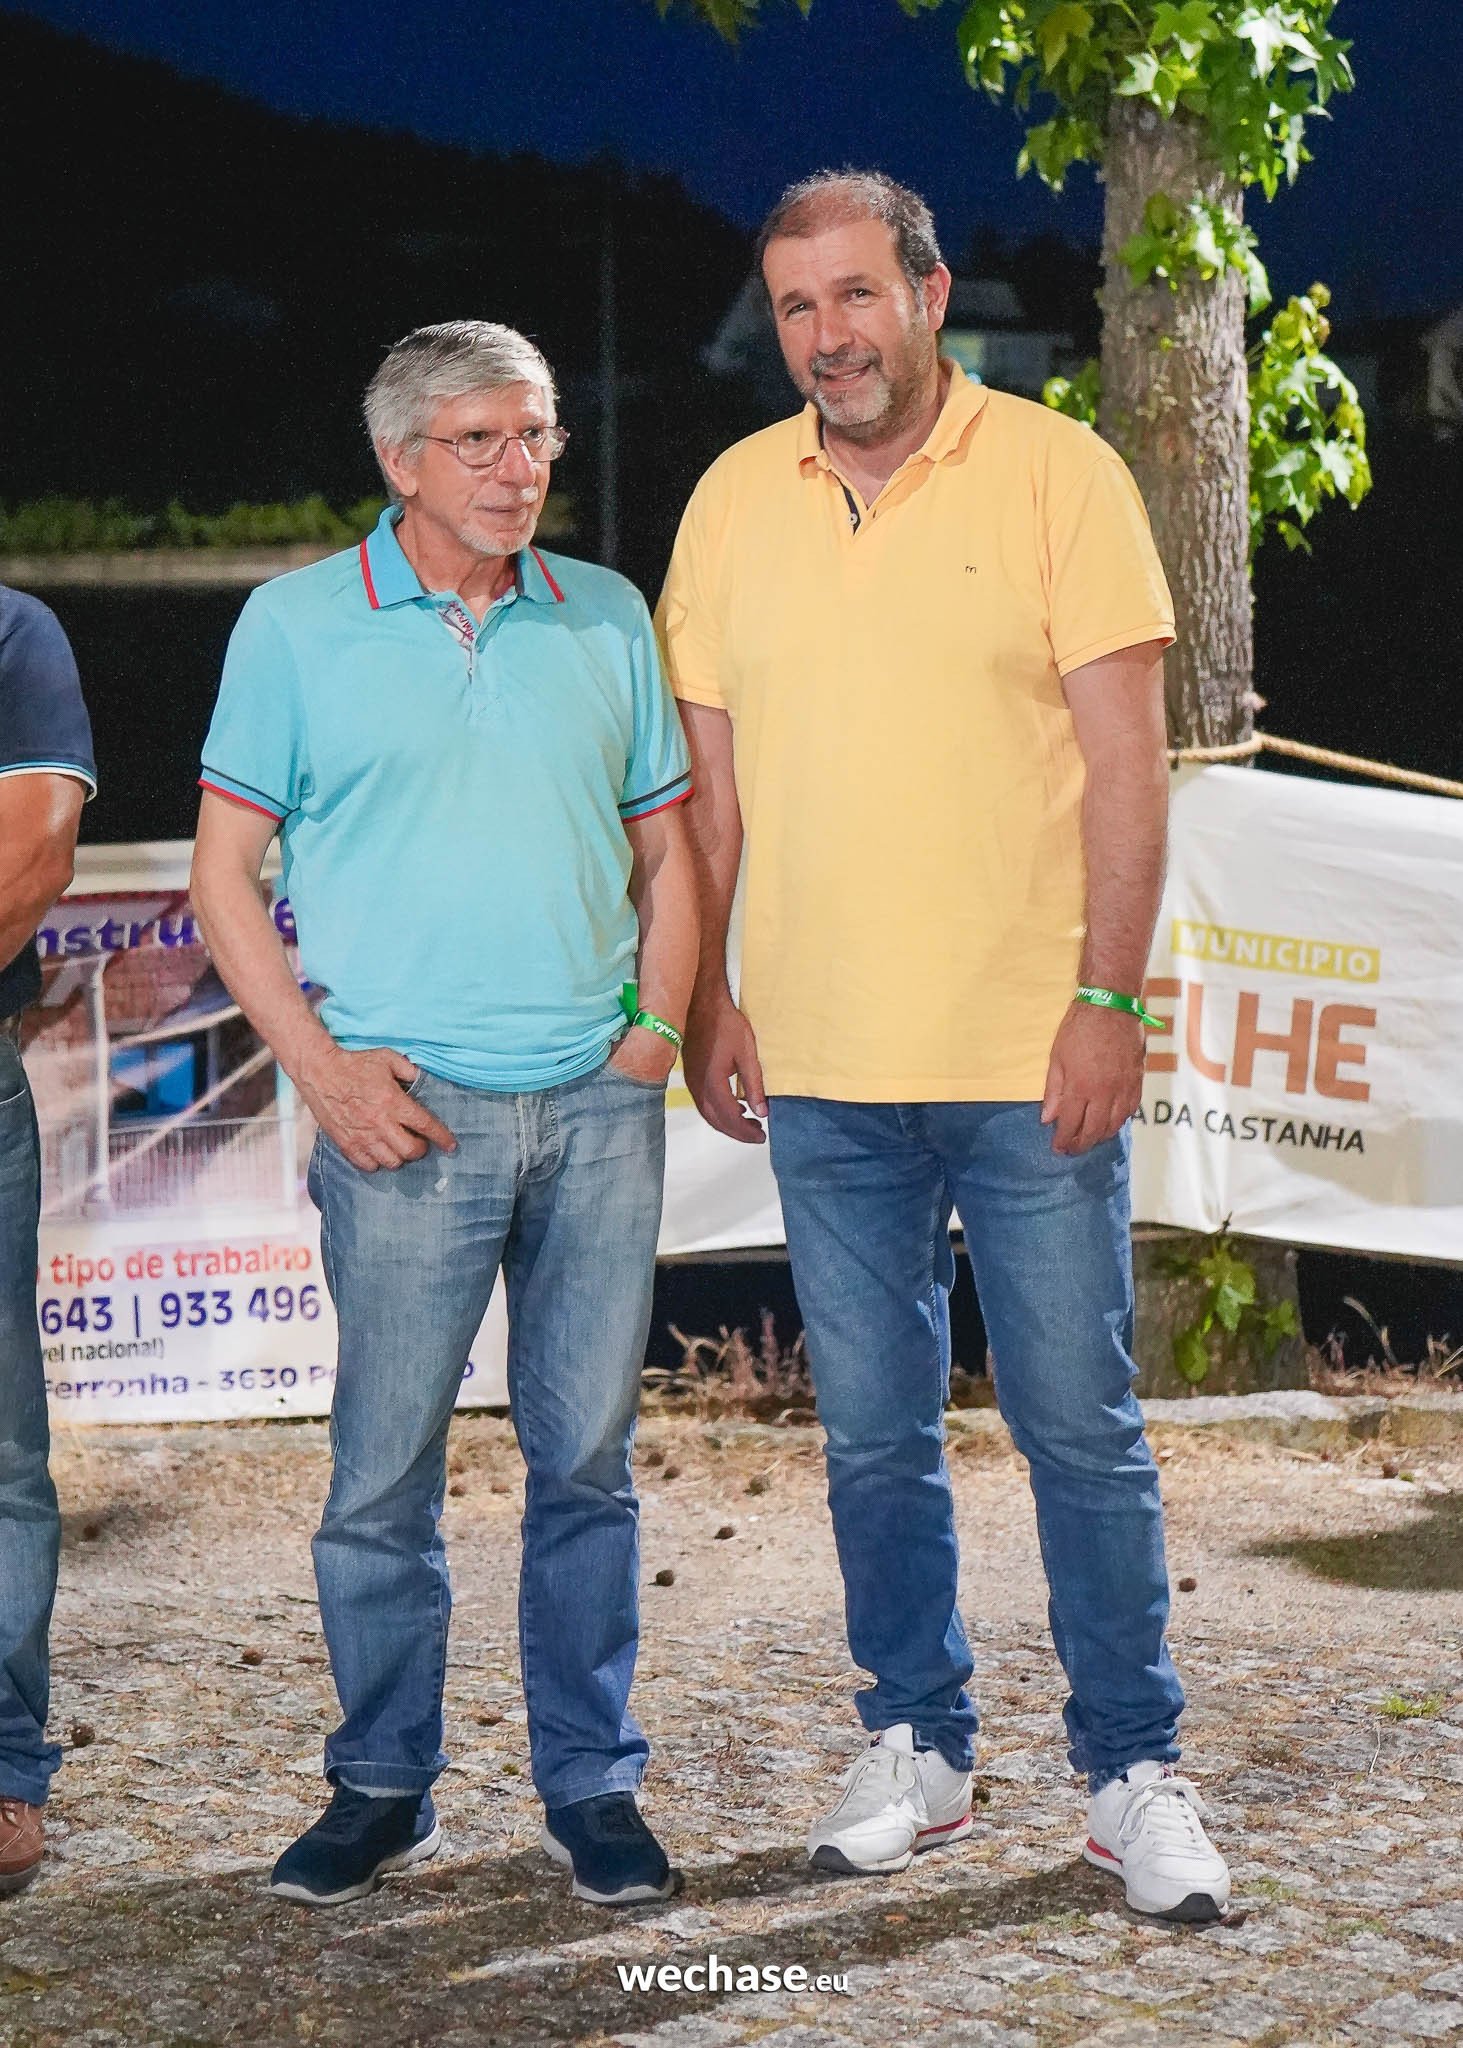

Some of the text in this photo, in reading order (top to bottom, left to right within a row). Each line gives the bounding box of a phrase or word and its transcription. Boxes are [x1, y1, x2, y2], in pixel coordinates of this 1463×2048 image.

[1142, 977, 1377, 1103] ELHE
[1153, 1100, 1193, 1128] DA
[1204, 1110, 1365, 1154] CASTANHA
[50, 1253, 116, 1288] tipo
[125, 1250, 164, 1280] de
[41, 1297, 114, 1335] 643
[160, 1289, 233, 1329] 933
[247, 1284, 321, 1323] 496
[219, 1366, 298, 1391] 3630
